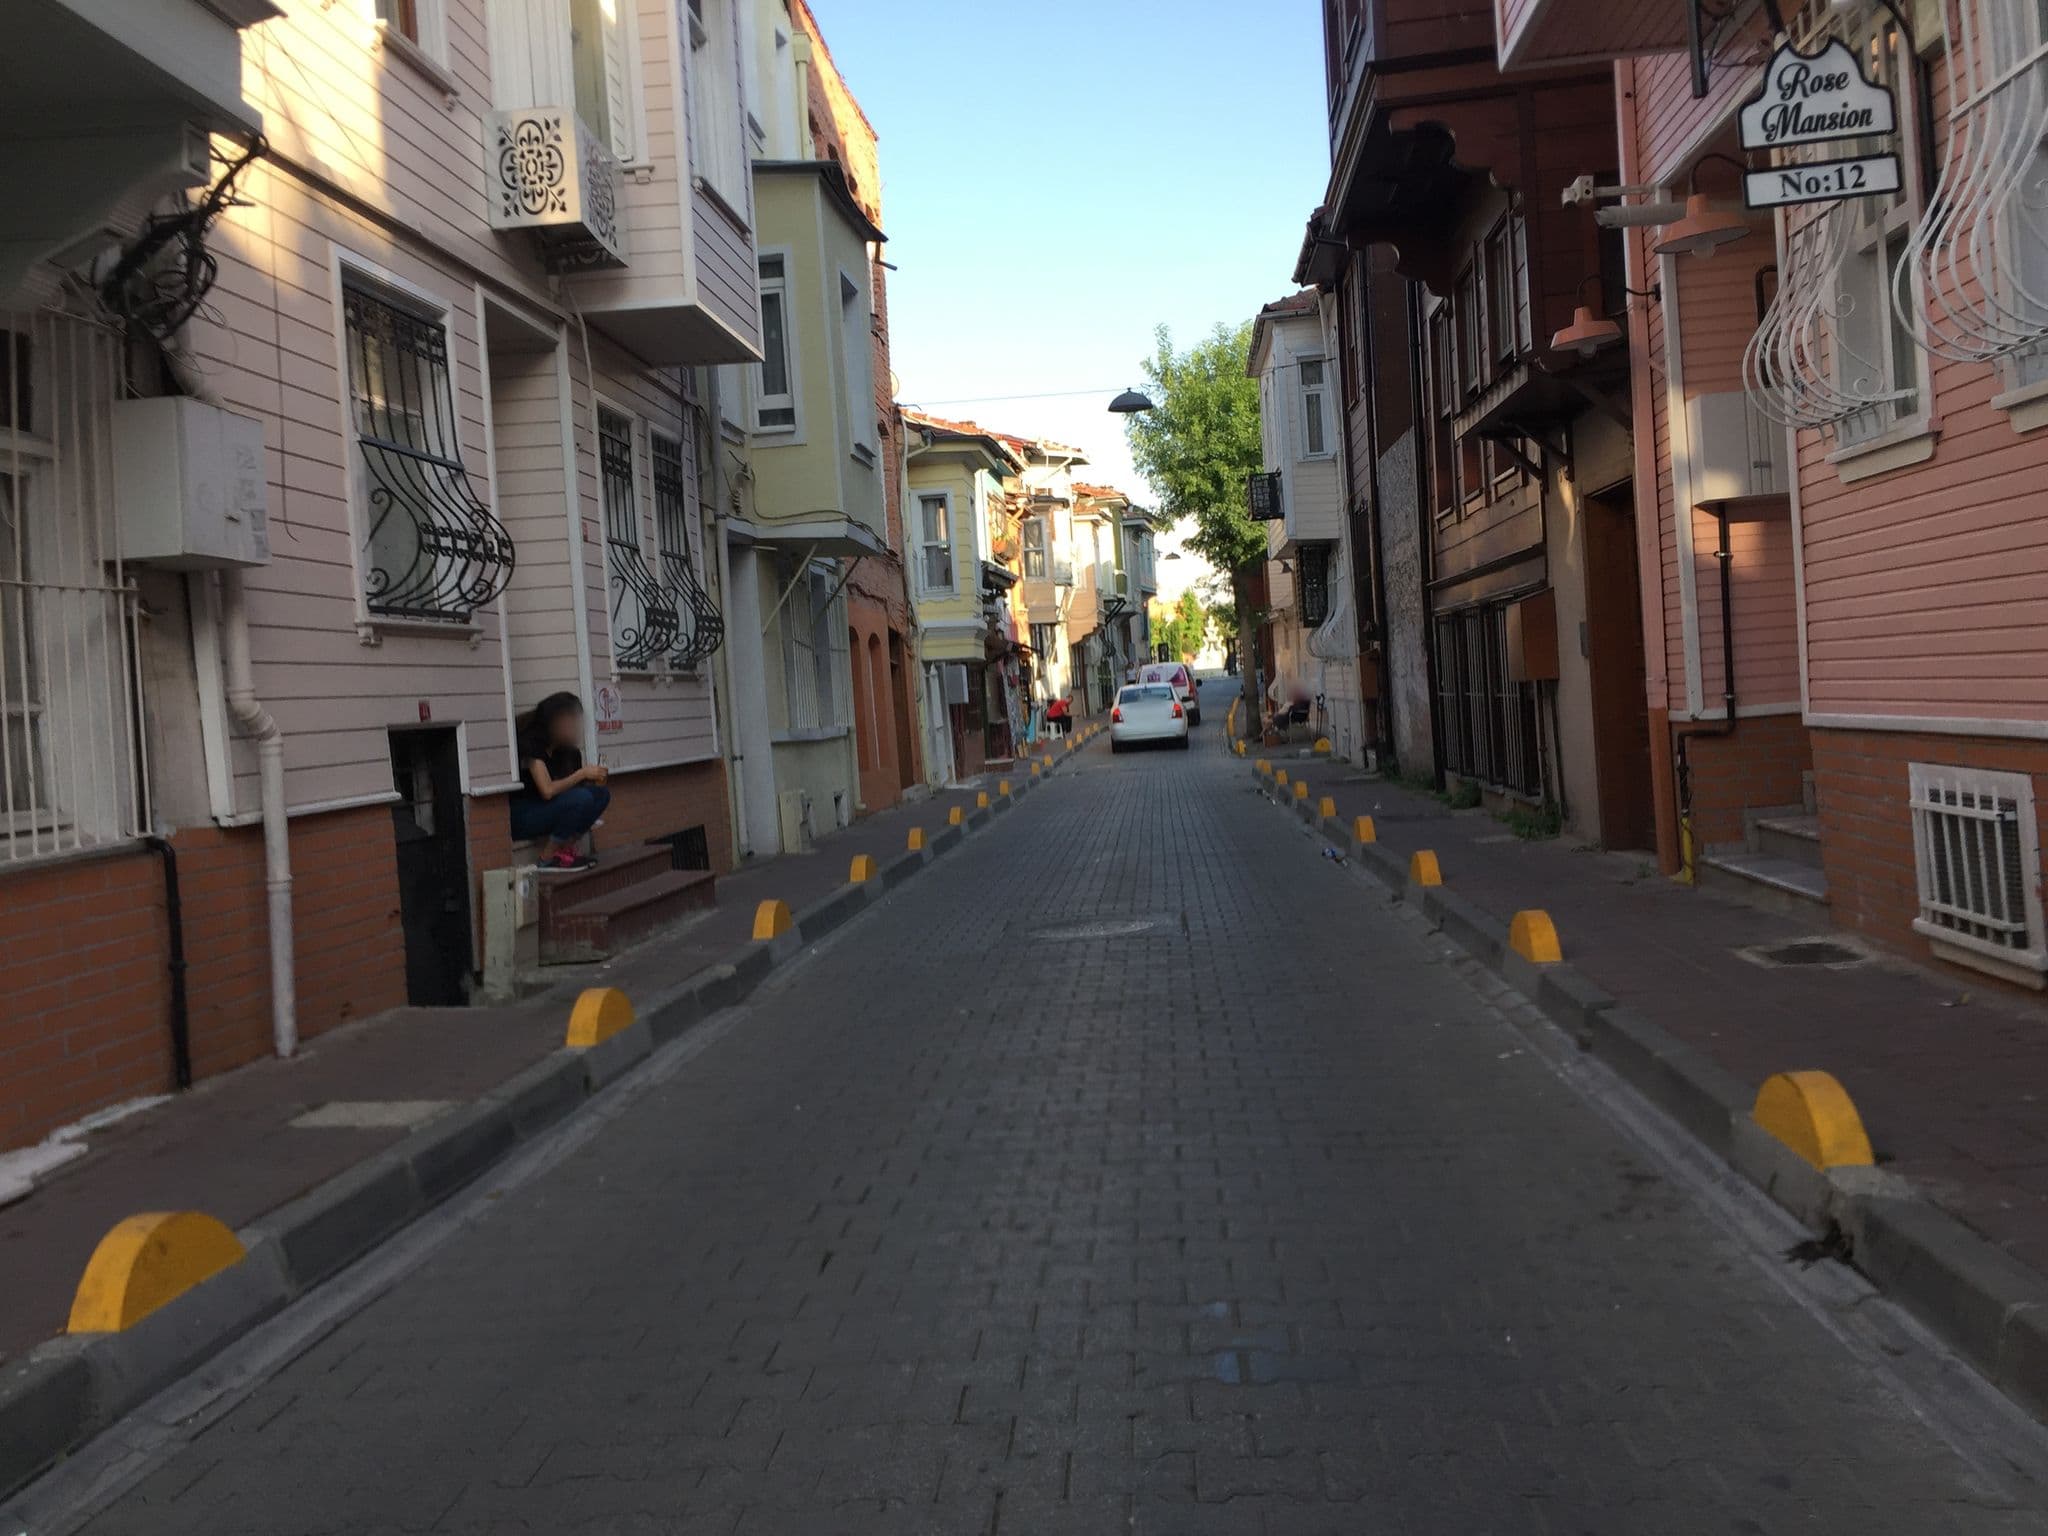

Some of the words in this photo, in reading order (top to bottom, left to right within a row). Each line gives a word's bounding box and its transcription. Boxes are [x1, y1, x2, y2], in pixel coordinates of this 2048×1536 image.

[1777, 62, 1849, 101] Rose
[1762, 101, 1873, 142] Mansion
[1780, 164, 1866, 198] No:12
